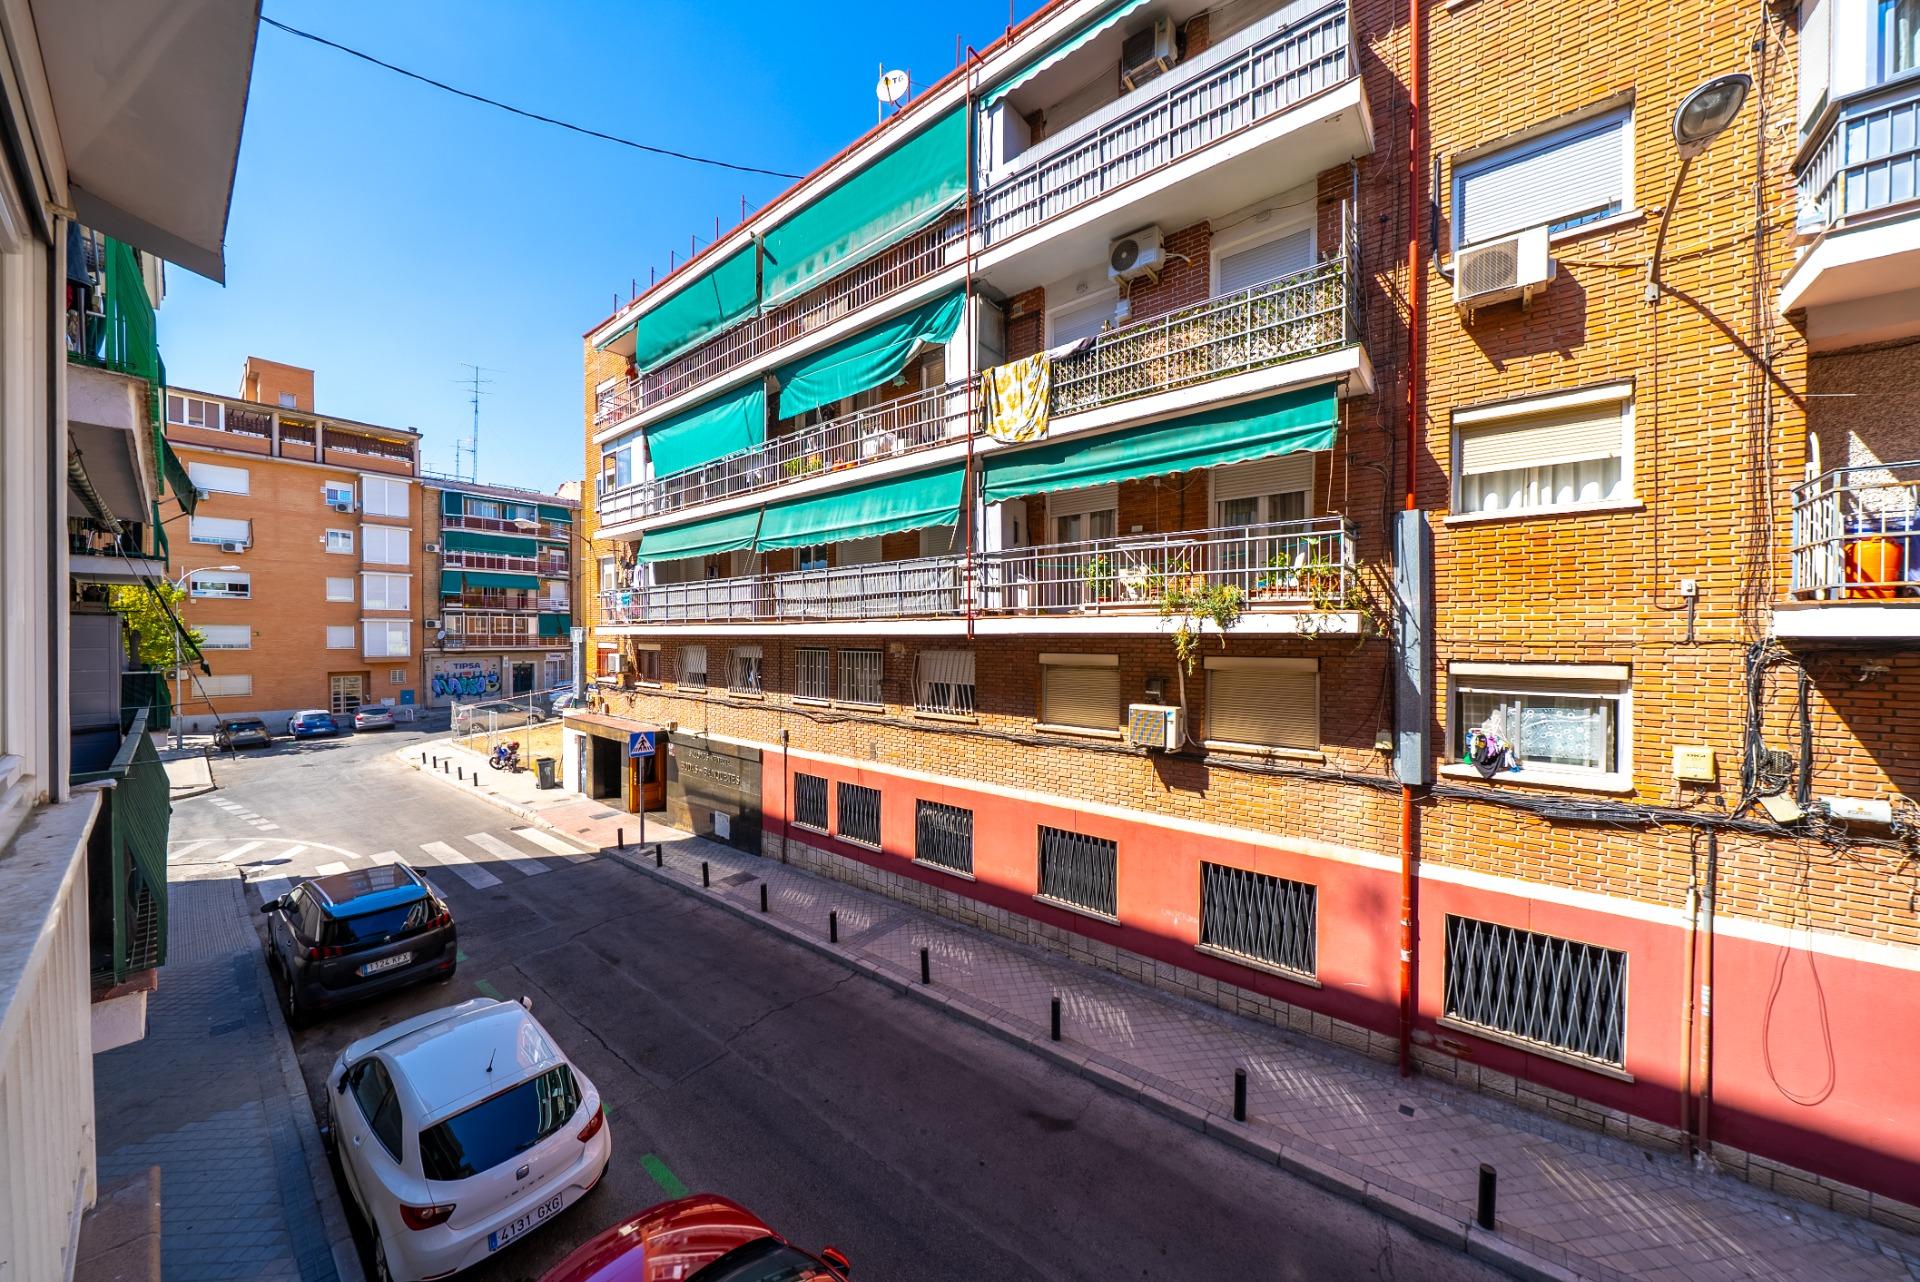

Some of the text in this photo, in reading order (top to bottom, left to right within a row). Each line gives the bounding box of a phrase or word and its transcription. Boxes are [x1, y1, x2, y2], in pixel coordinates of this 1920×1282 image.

[453, 662, 481, 670] TIPSA
[502, 1197, 560, 1241] 4131 GXG
